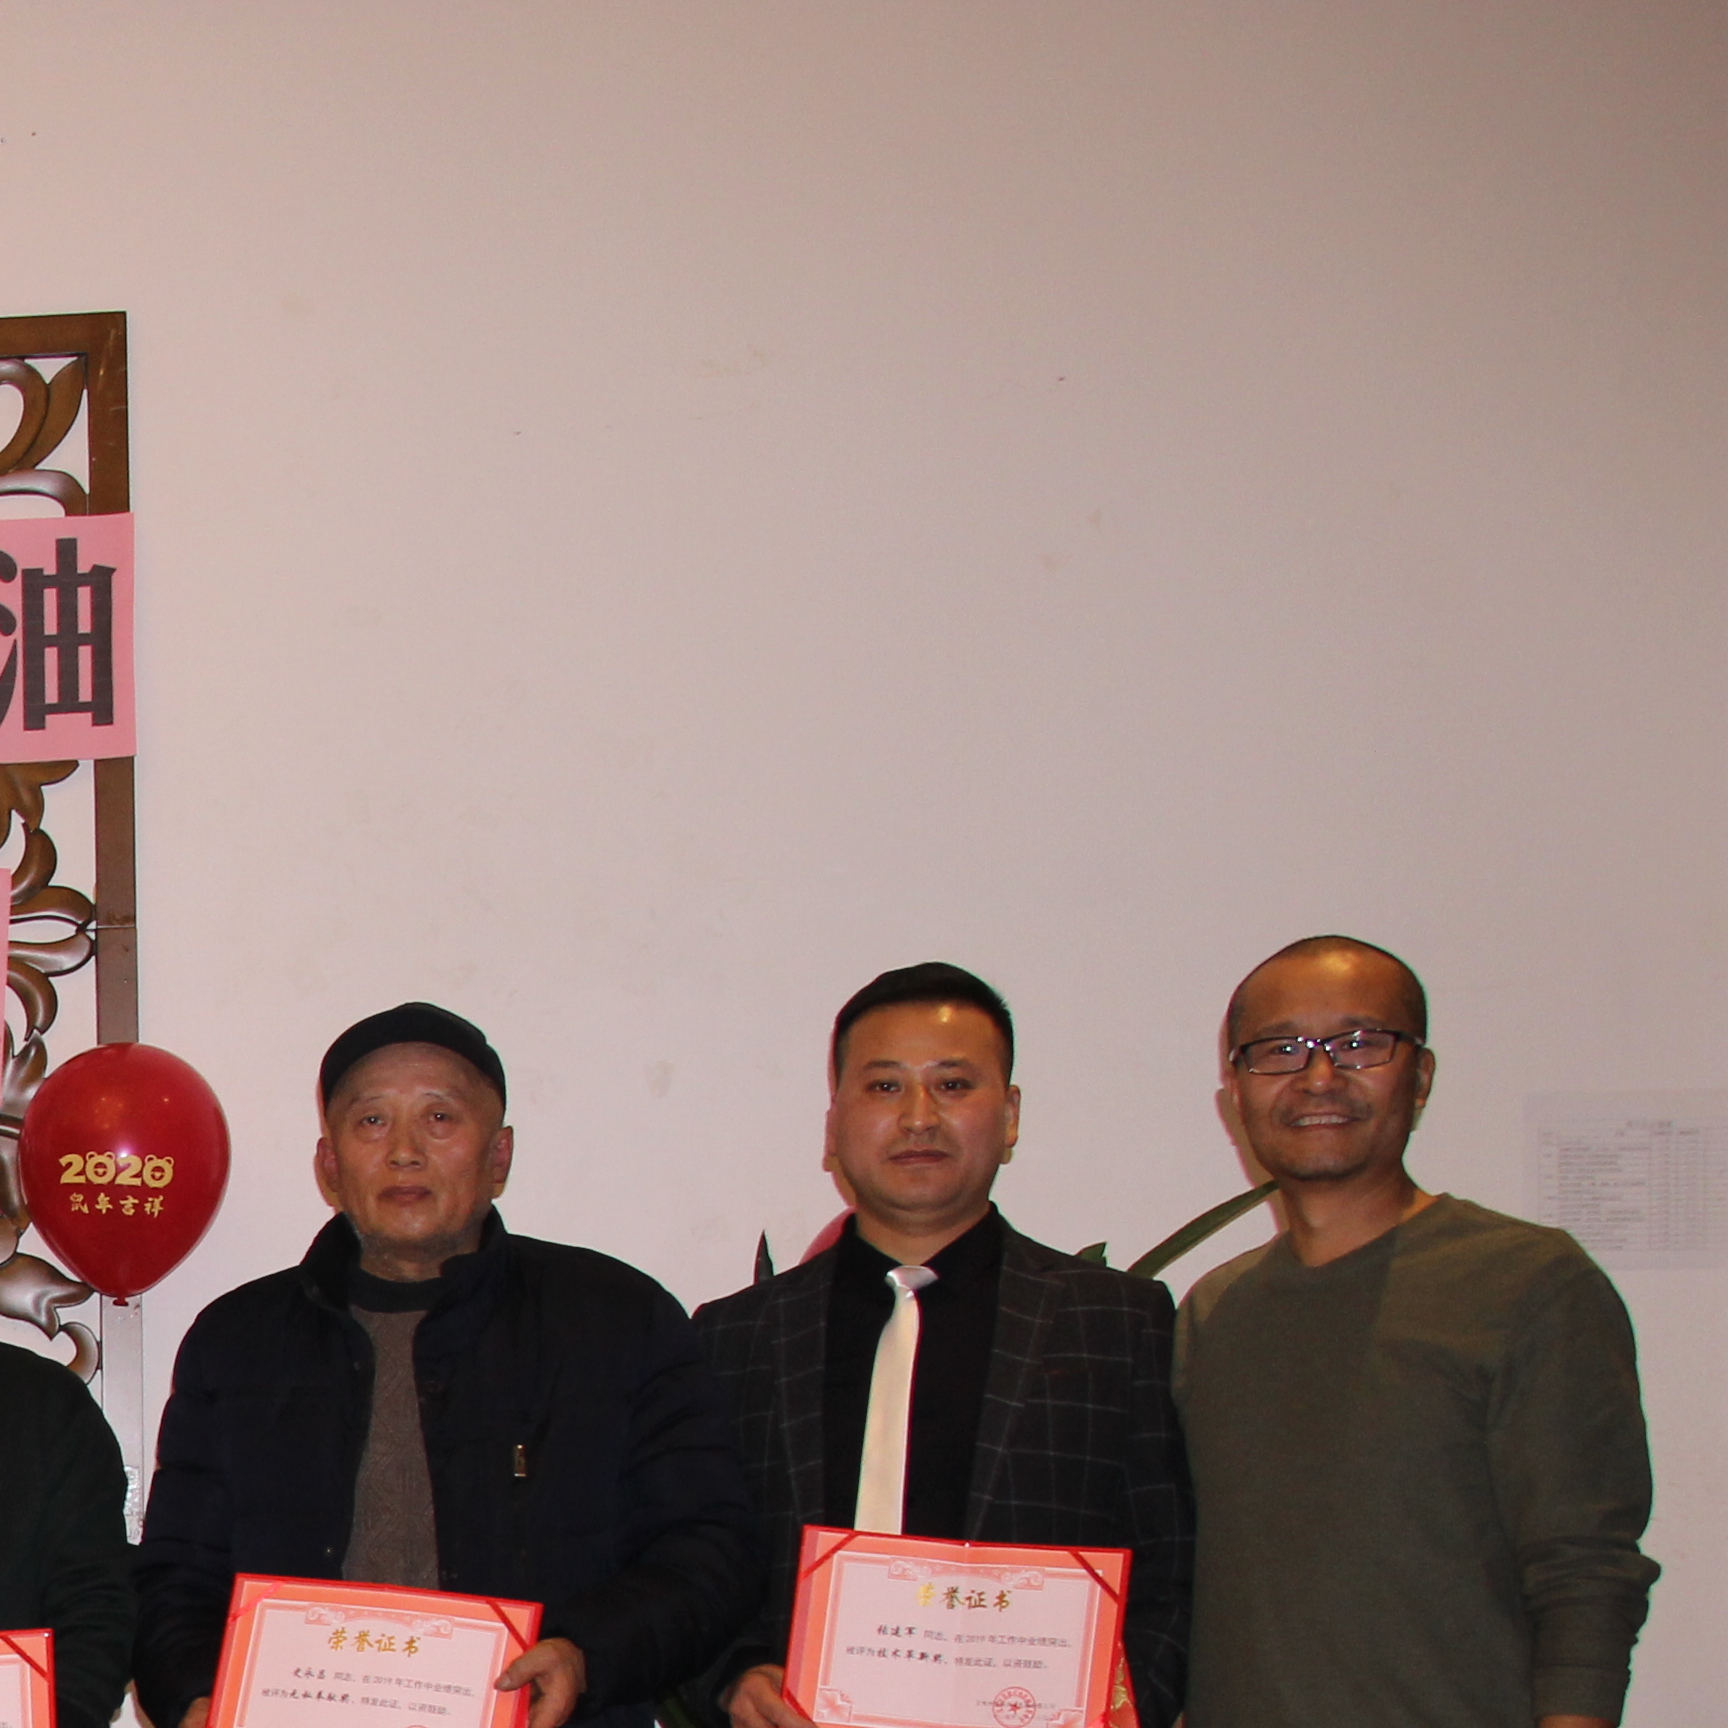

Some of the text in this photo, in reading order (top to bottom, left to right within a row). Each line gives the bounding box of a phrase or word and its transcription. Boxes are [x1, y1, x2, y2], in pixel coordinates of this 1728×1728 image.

[58, 1151, 175, 1188] 2020
[69, 1192, 164, 1218] 鼠年吉祥
[916, 1582, 1013, 1612] 荣誉证书
[327, 1627, 422, 1657] 荣誉证书
